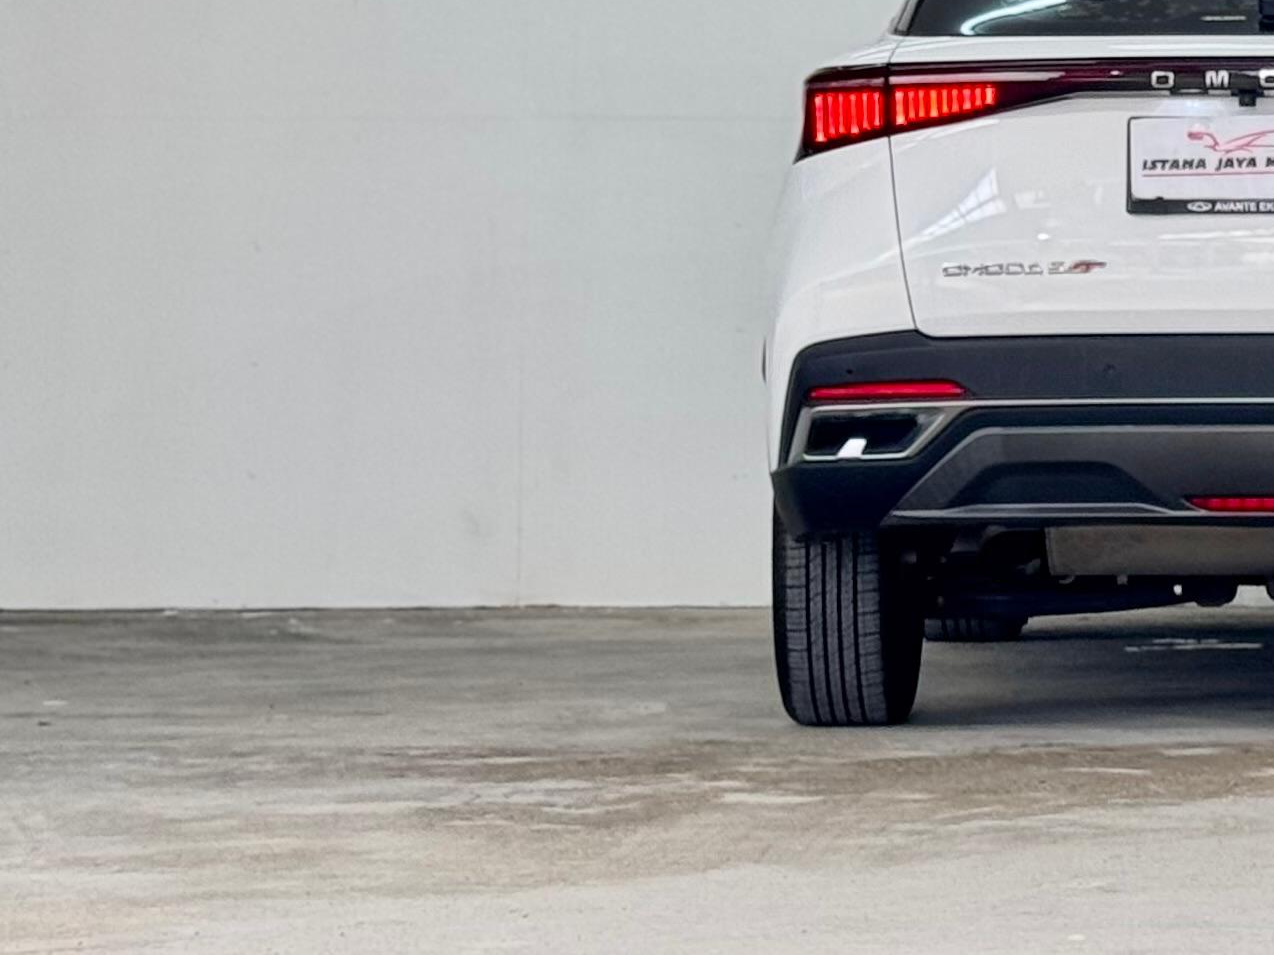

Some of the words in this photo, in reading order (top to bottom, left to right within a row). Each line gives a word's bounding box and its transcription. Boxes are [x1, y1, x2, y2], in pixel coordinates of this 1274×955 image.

[1142, 159, 1207, 171] ISTANA
[1215, 156, 1257, 172] JAYA
[1214, 201, 1257, 212] AVANTE
